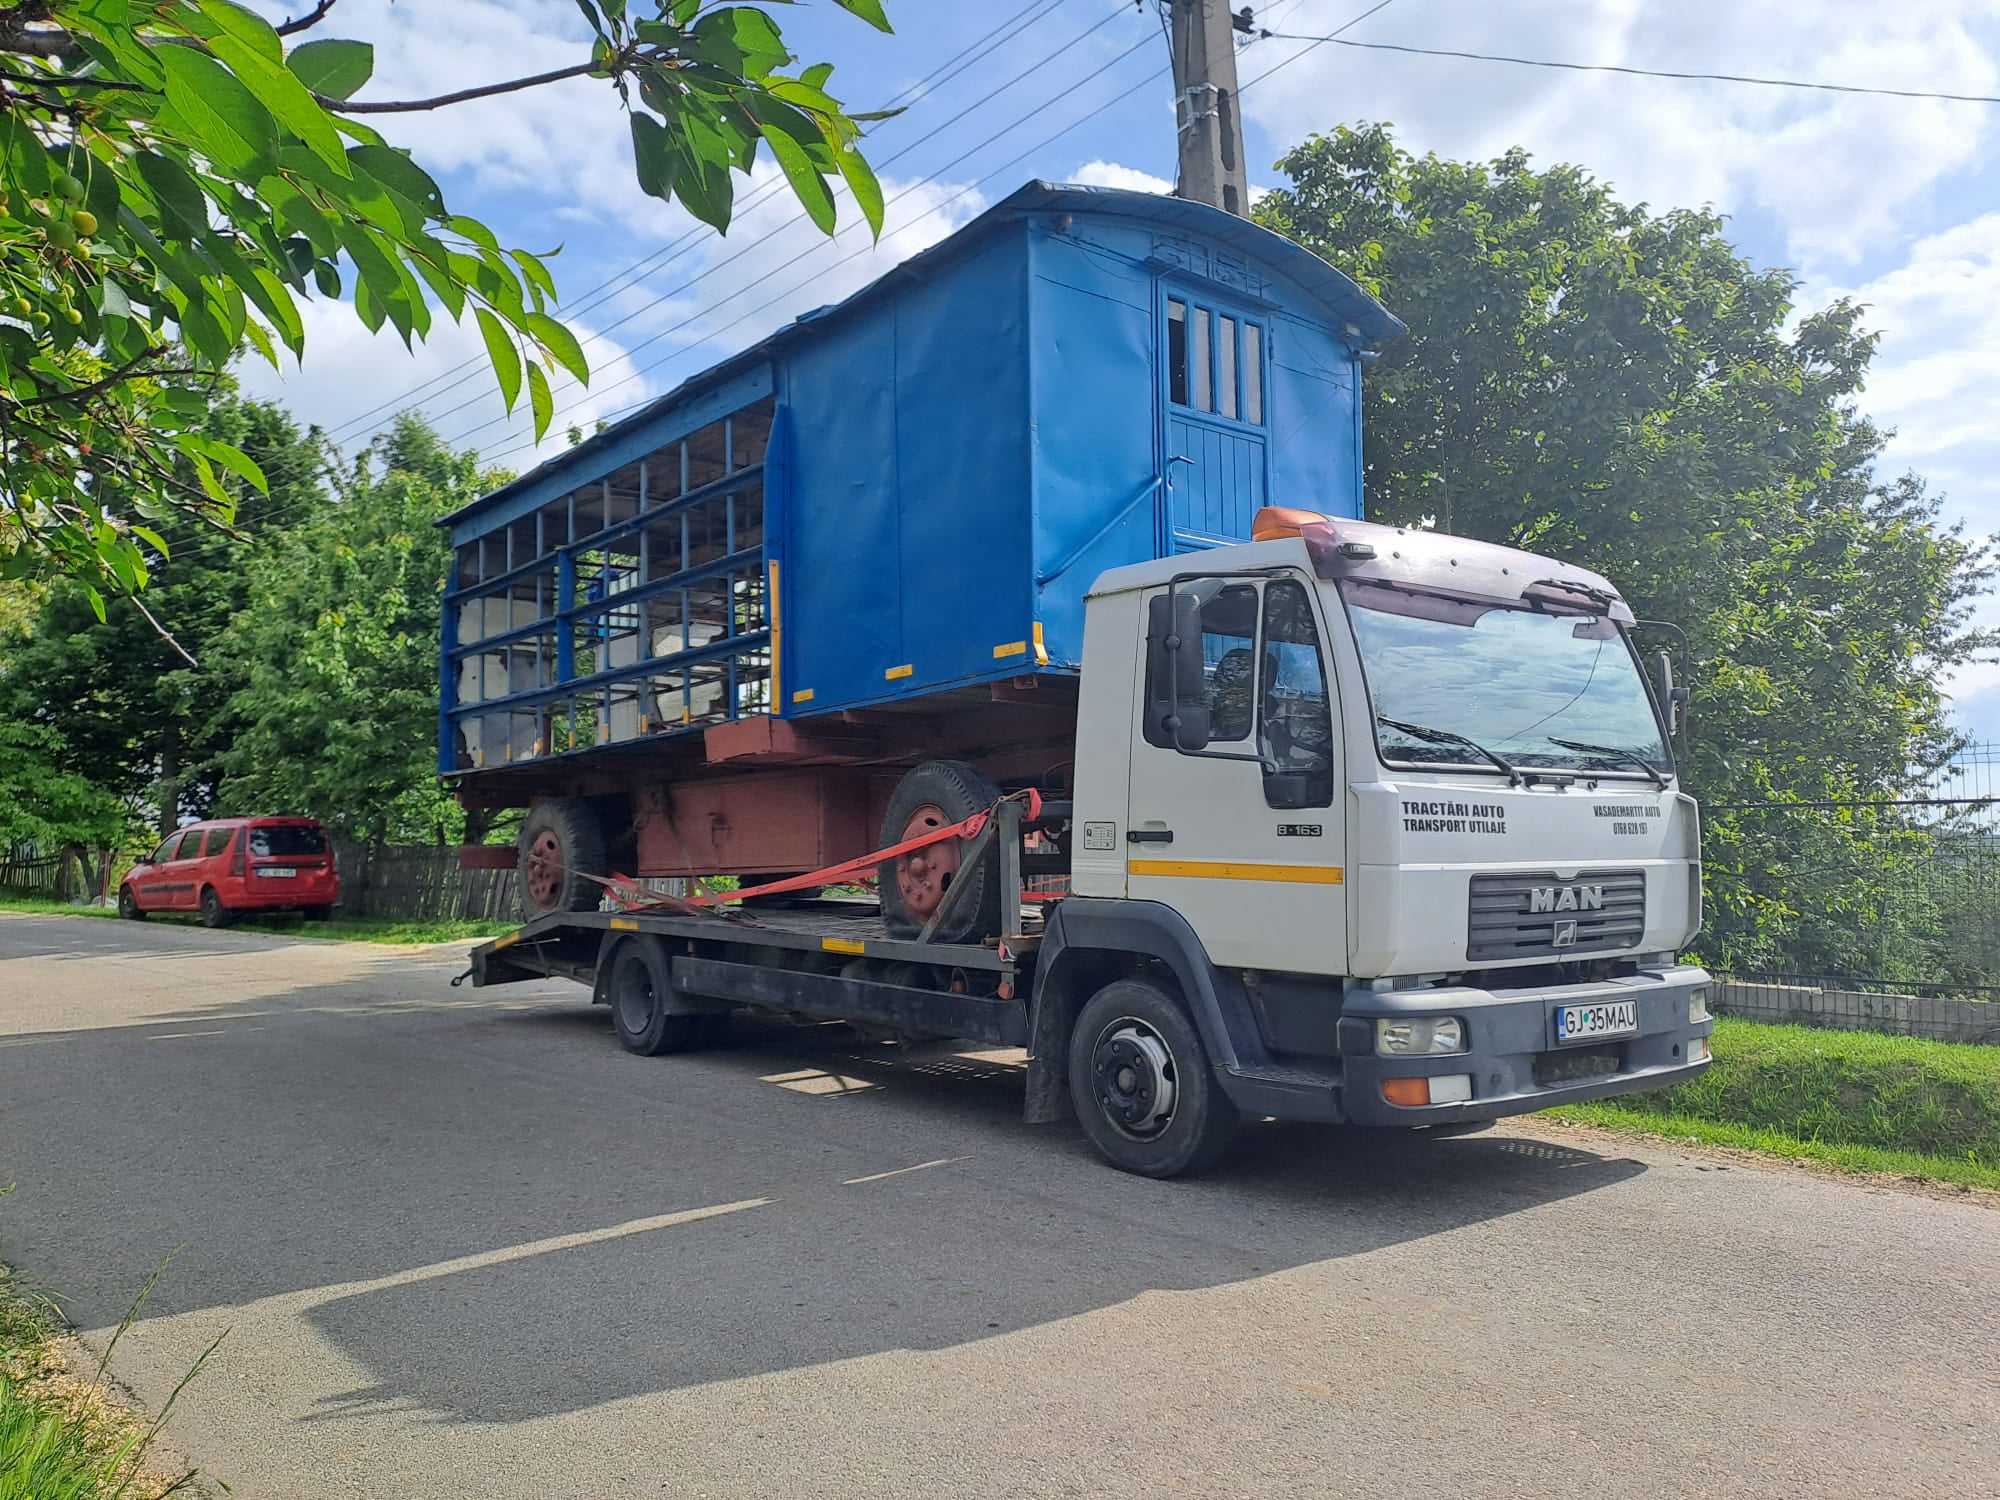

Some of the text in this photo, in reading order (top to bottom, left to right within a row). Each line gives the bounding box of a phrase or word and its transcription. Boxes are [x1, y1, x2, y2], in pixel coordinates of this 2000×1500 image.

[1472, 804, 1504, 818] AUTO
[1645, 806, 1661, 817] AUTO
[1403, 819, 1506, 834] TRANSPORT UTILAJE
[1530, 886, 1602, 913] MAN
